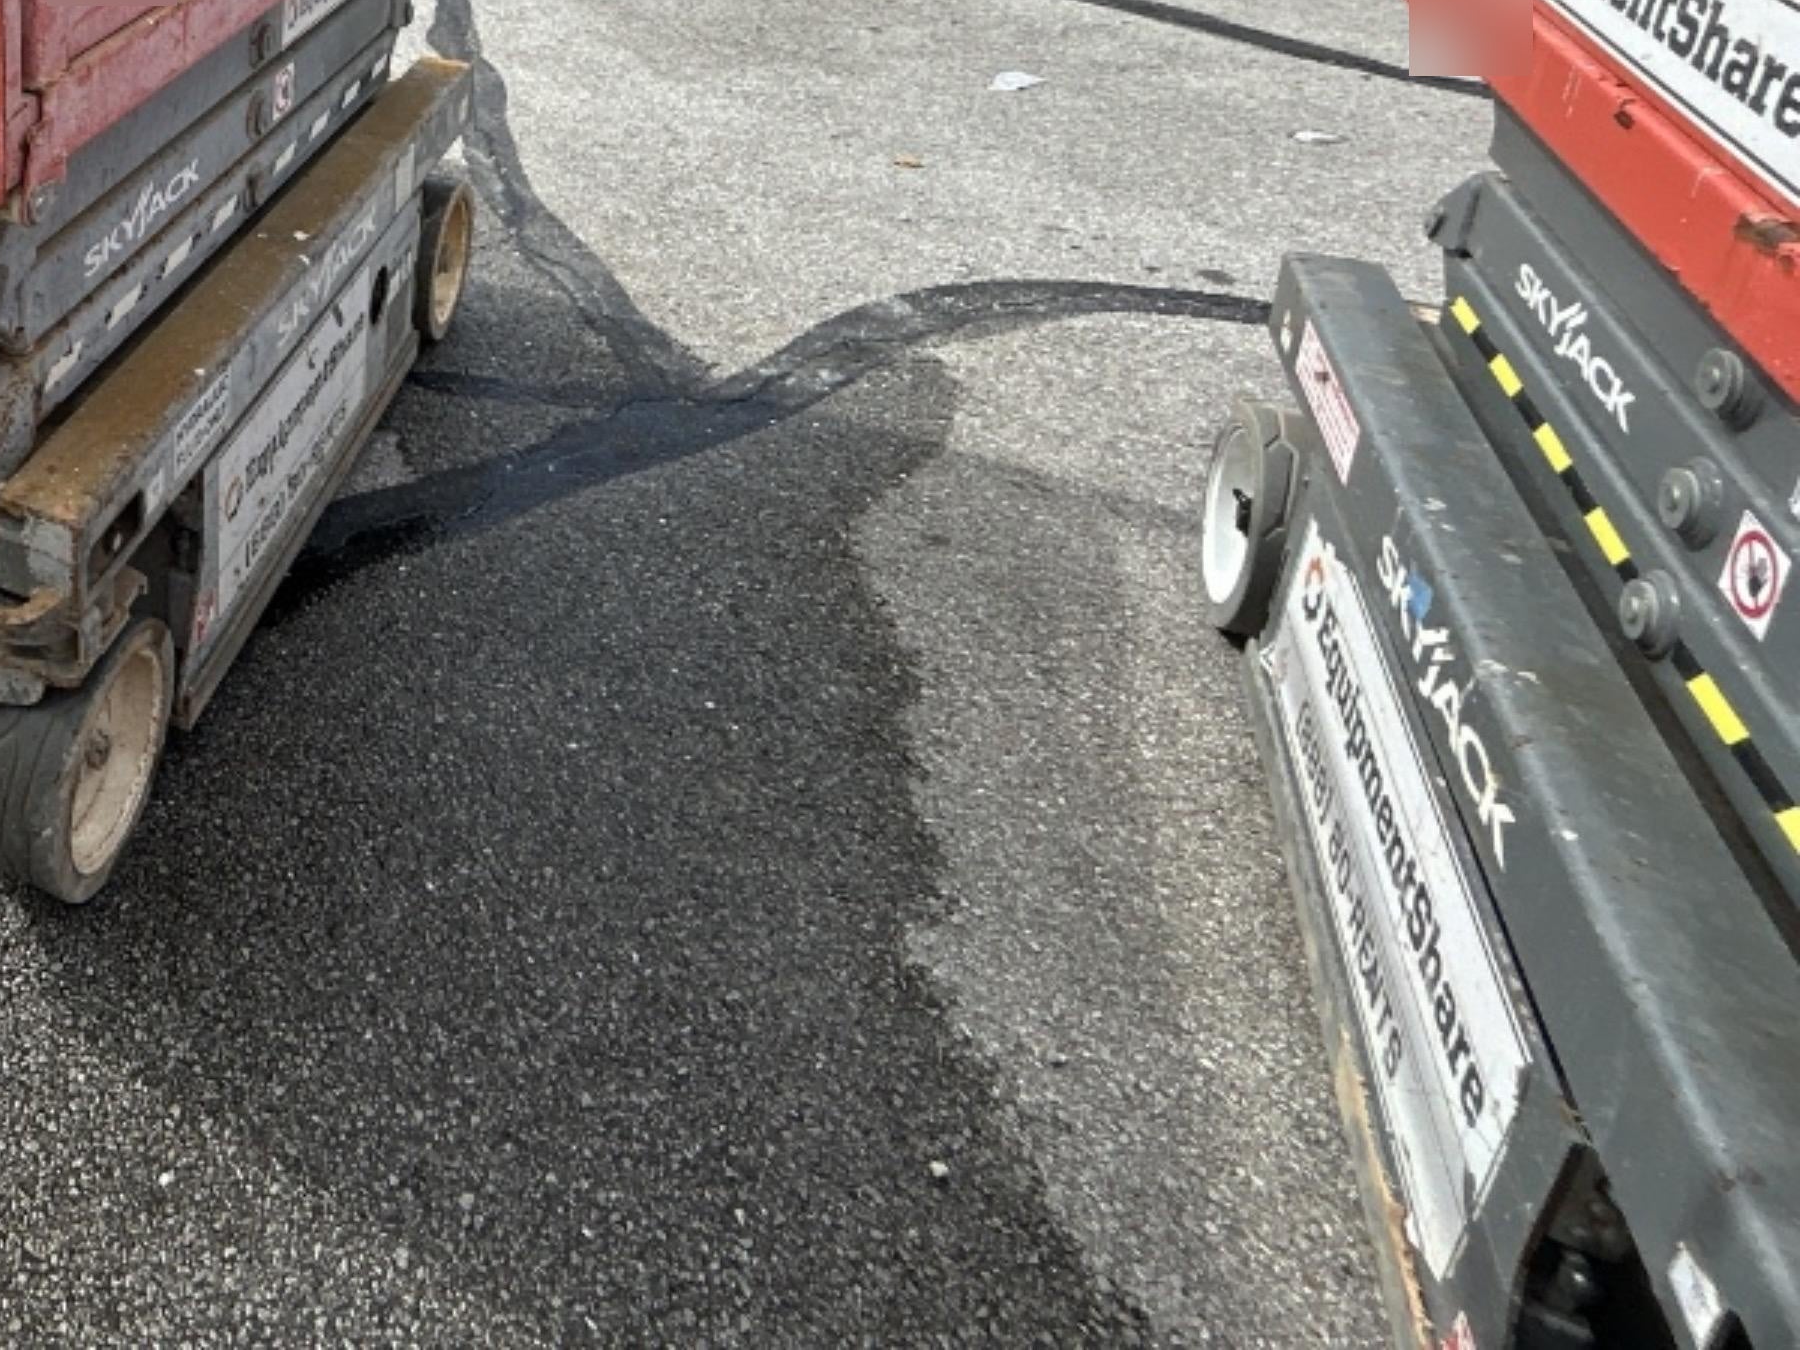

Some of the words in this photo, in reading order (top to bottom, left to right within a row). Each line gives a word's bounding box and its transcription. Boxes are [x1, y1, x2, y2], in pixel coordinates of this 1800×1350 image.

[83, 157, 200, 278] SKYJACK
[1513, 262, 1636, 435] SKYJACK
[1317, 602, 1487, 1129] EquipmentShare
